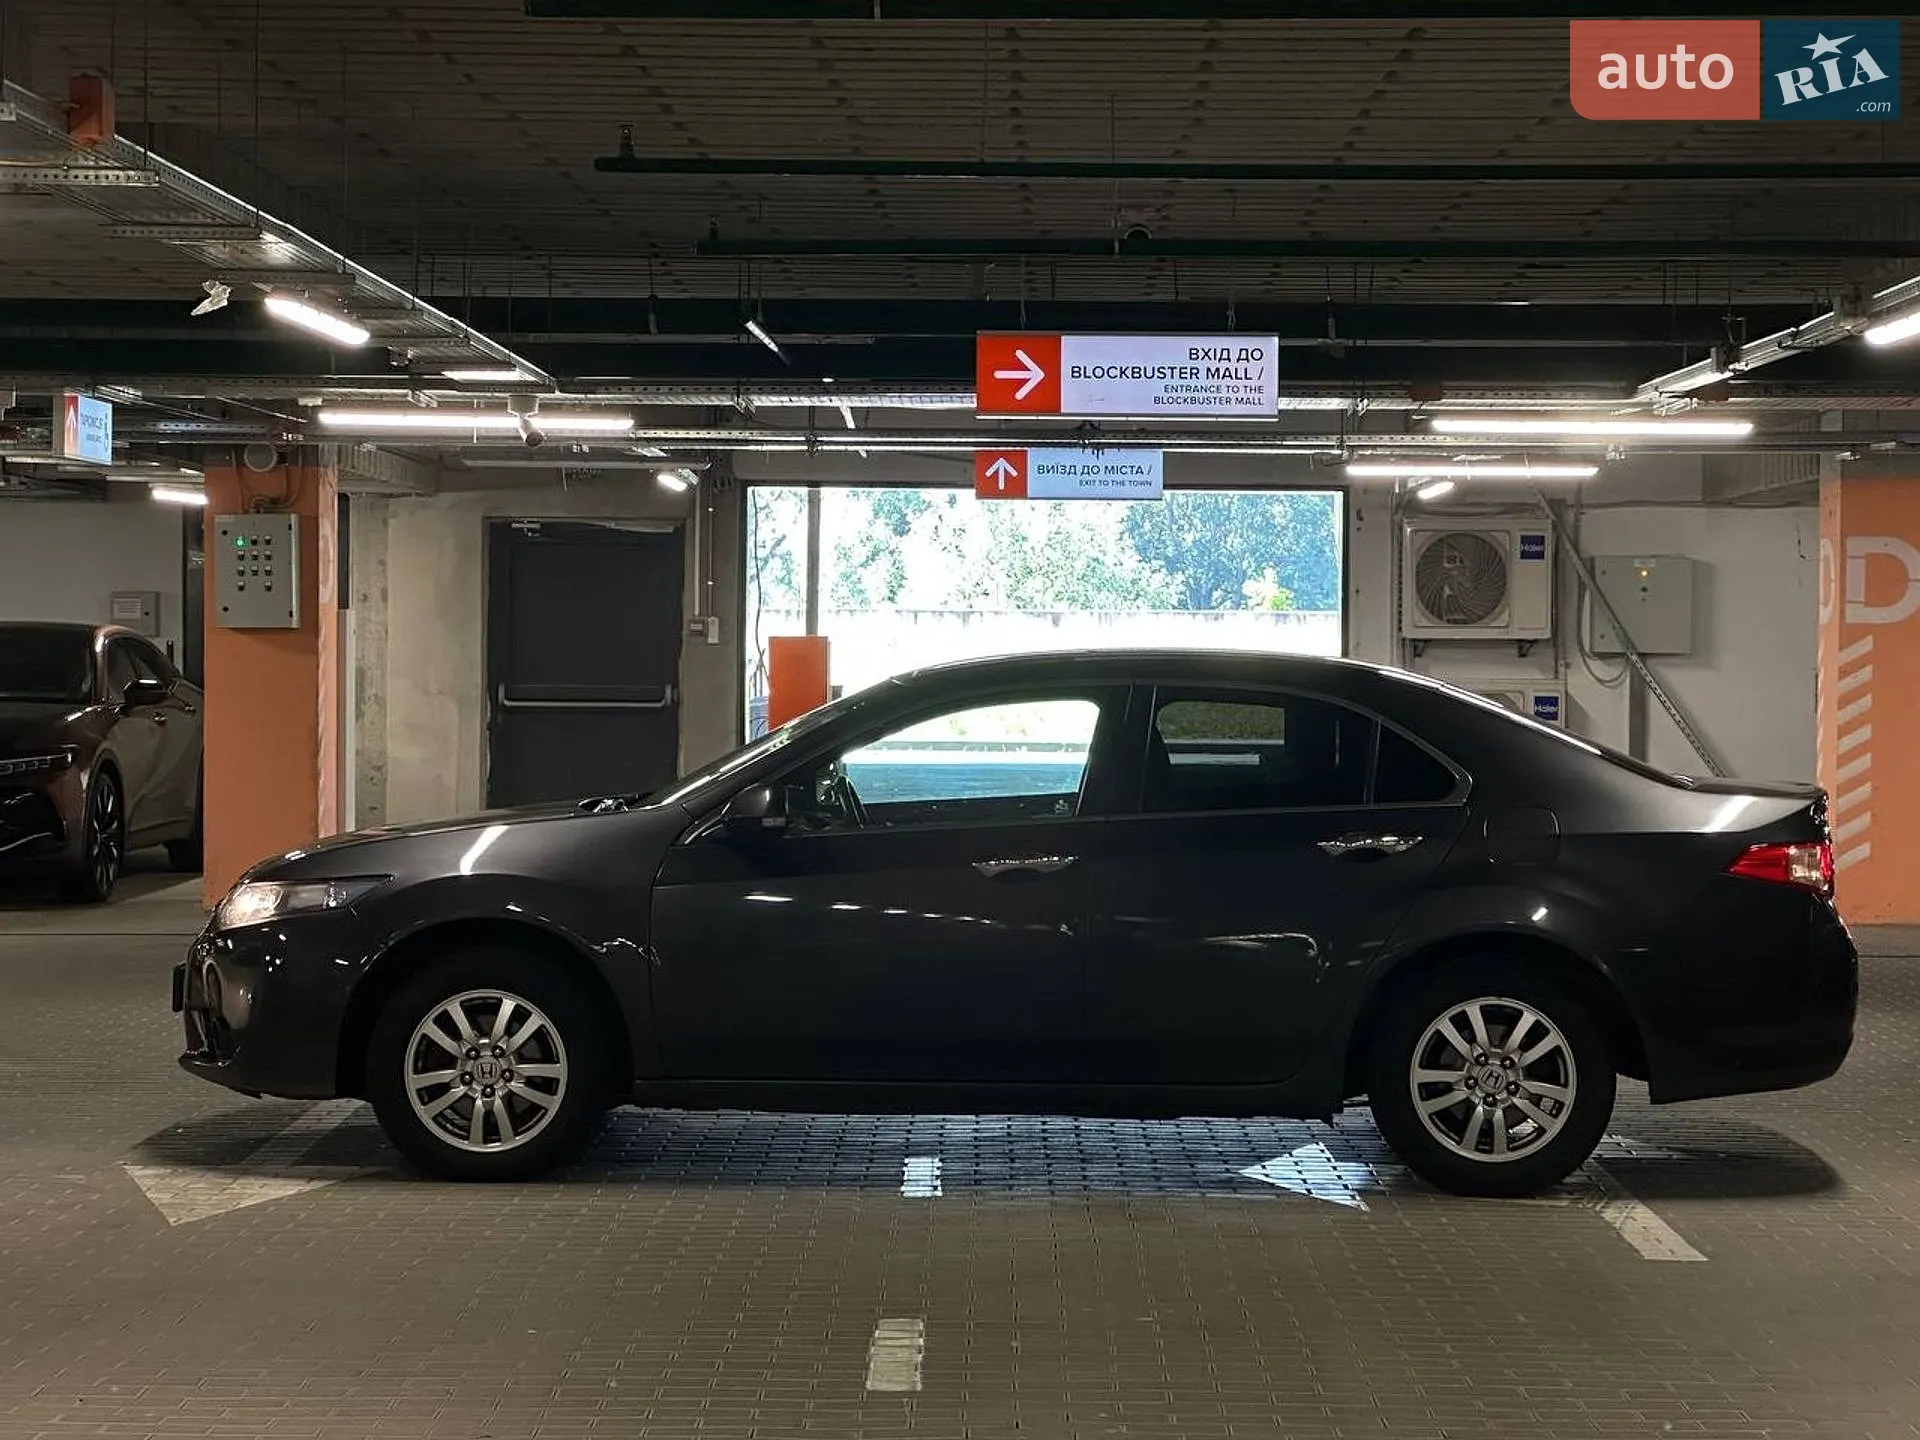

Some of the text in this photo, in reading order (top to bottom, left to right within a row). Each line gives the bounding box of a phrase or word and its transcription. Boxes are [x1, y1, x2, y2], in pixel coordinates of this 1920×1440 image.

[1189, 347, 1264, 363] ВХІД ДО
[1070, 365, 1200, 380] BLOCKBUSTER
[1205, 366, 1252, 381] MALL
[1163, 384, 1264, 394] ENTRANCE TO THE
[1153, 396, 1264, 406] BLOCKBUSTER MALL
[1036, 463, 1077, 475] ВИЇЗД
[1080, 464, 1101, 475] ДО
[1104, 464, 1144, 475] МІСТА
[1845, 536, 1920, 624] D
